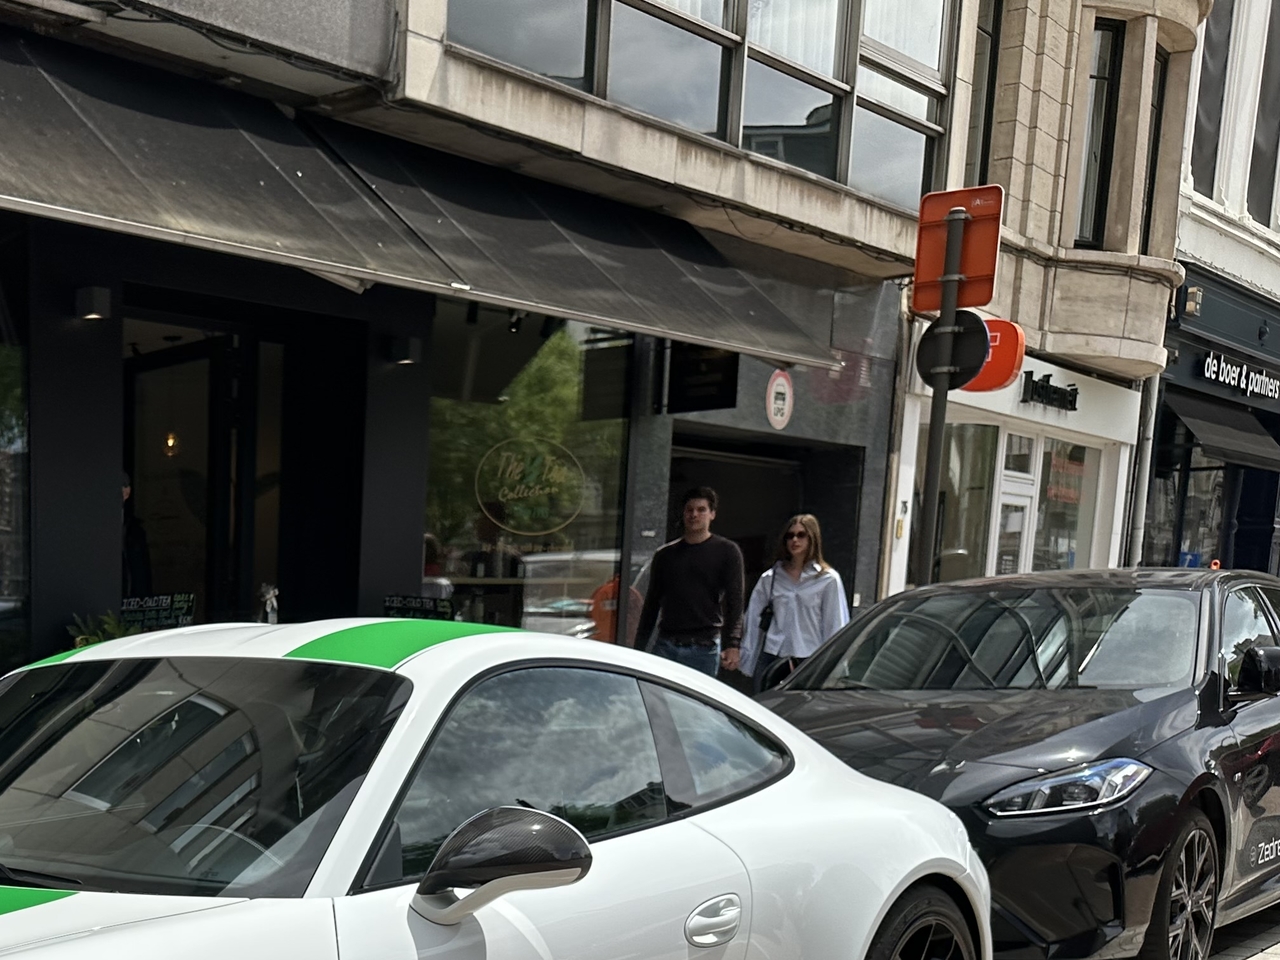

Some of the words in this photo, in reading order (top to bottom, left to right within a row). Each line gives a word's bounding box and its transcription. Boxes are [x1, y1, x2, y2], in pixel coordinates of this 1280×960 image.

[1204, 351, 1218, 380] de
[1218, 354, 1241, 387] boer
[1240, 364, 1248, 389] &
[1247, 369, 1280, 400] partners
